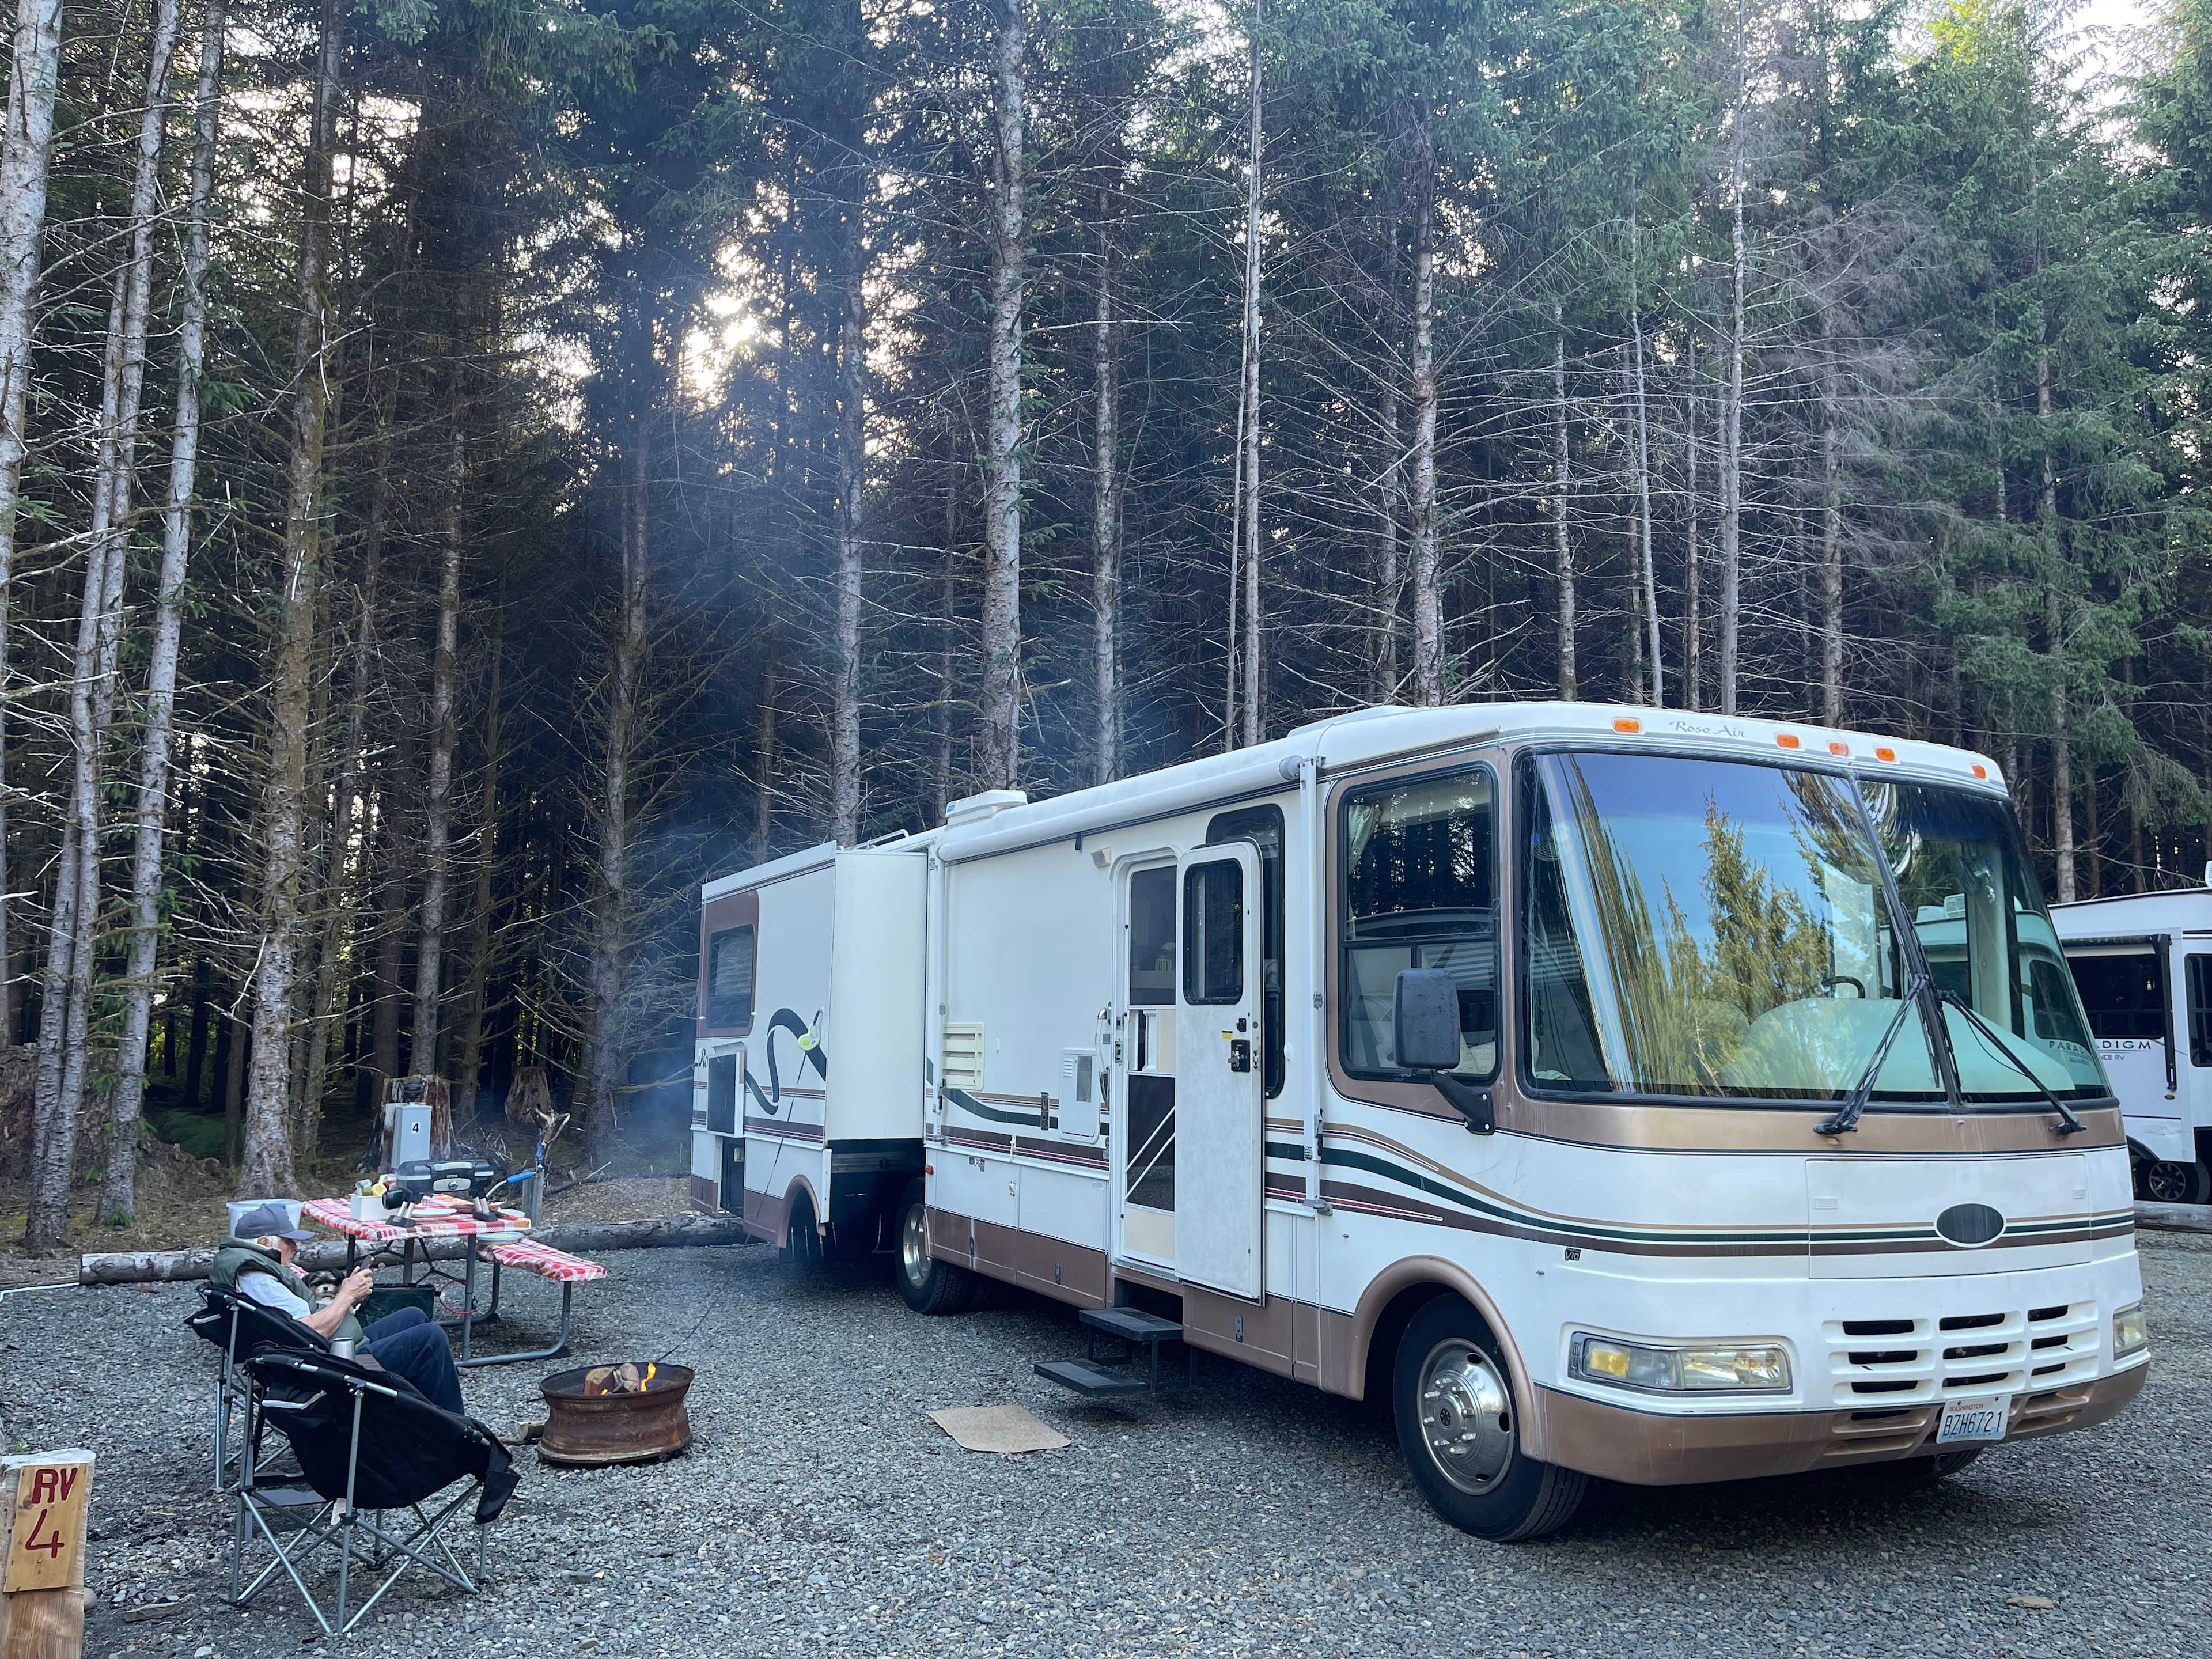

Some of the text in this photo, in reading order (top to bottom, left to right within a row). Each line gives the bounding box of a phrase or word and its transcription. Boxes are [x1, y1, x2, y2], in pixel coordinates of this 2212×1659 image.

[1669, 721, 1747, 738] Rose Air
[412, 1123, 419, 1133] 4
[1565, 1250, 1580, 1260] V10
[1949, 1403, 1985, 1411] WASHINGTON
[1942, 1410, 2002, 1436] BZH6721
[32, 1467, 78, 1504] RV
[25, 1509, 65, 1558] 4
